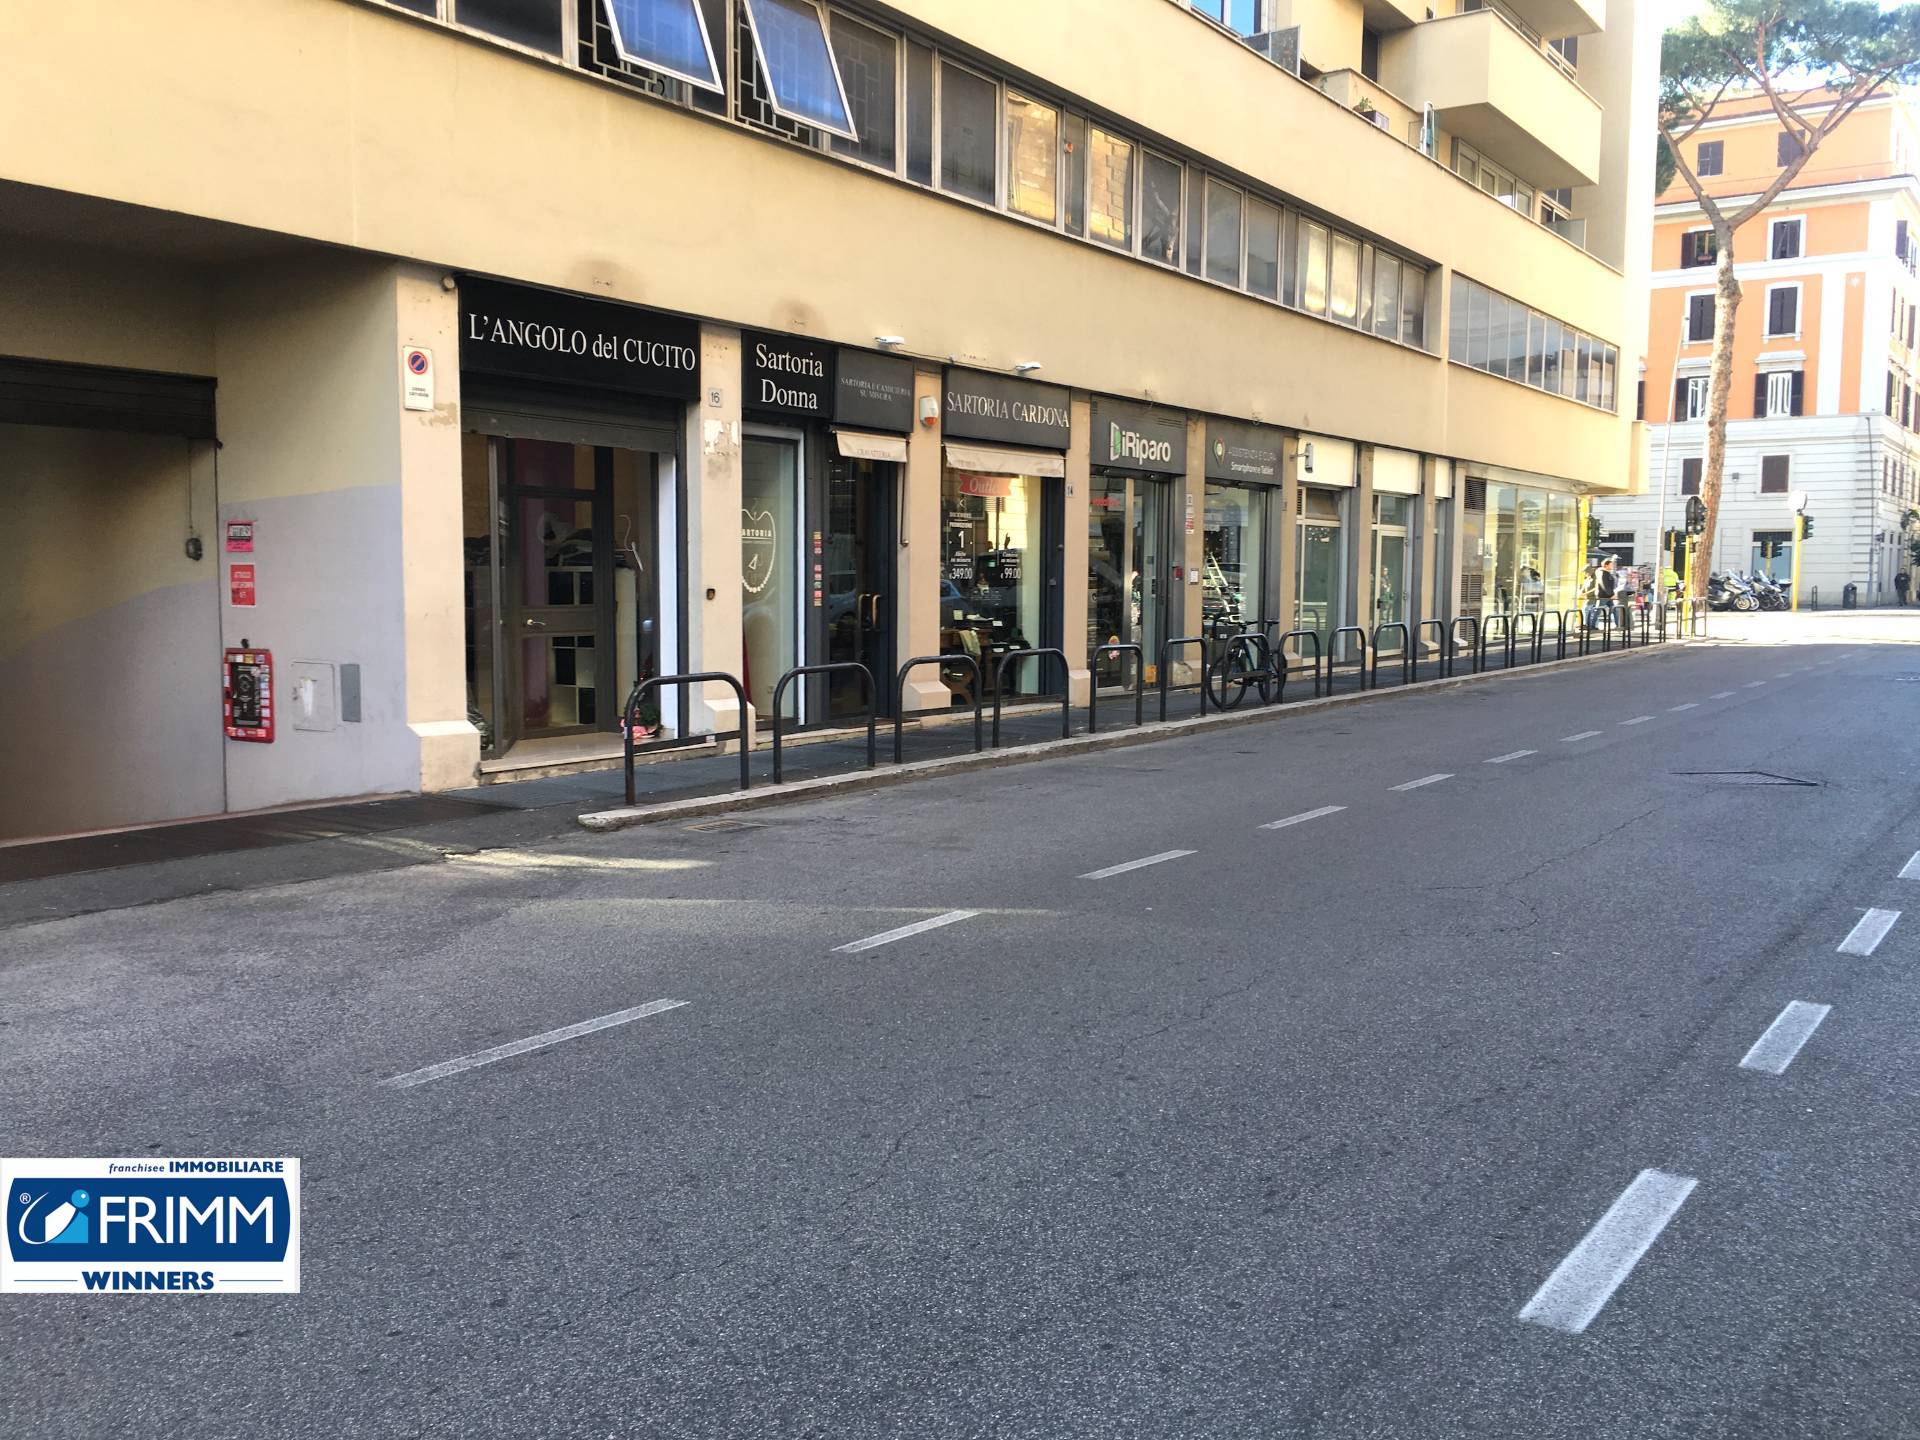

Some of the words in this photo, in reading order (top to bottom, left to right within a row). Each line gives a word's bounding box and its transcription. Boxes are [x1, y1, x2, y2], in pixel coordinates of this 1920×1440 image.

[469, 313, 587, 355] L'ANGOLO
[592, 334, 618, 360] del
[623, 338, 696, 371] CUCITO
[755, 343, 824, 377] Sartoria
[711, 391, 720, 403] 16
[760, 379, 818, 409] Donna
[947, 392, 1009, 419] SARTORIA
[1012, 401, 1070, 428] CARDONA
[1121, 430, 1171, 465] iRiparo
[741, 529, 772, 537] ARTORIA
